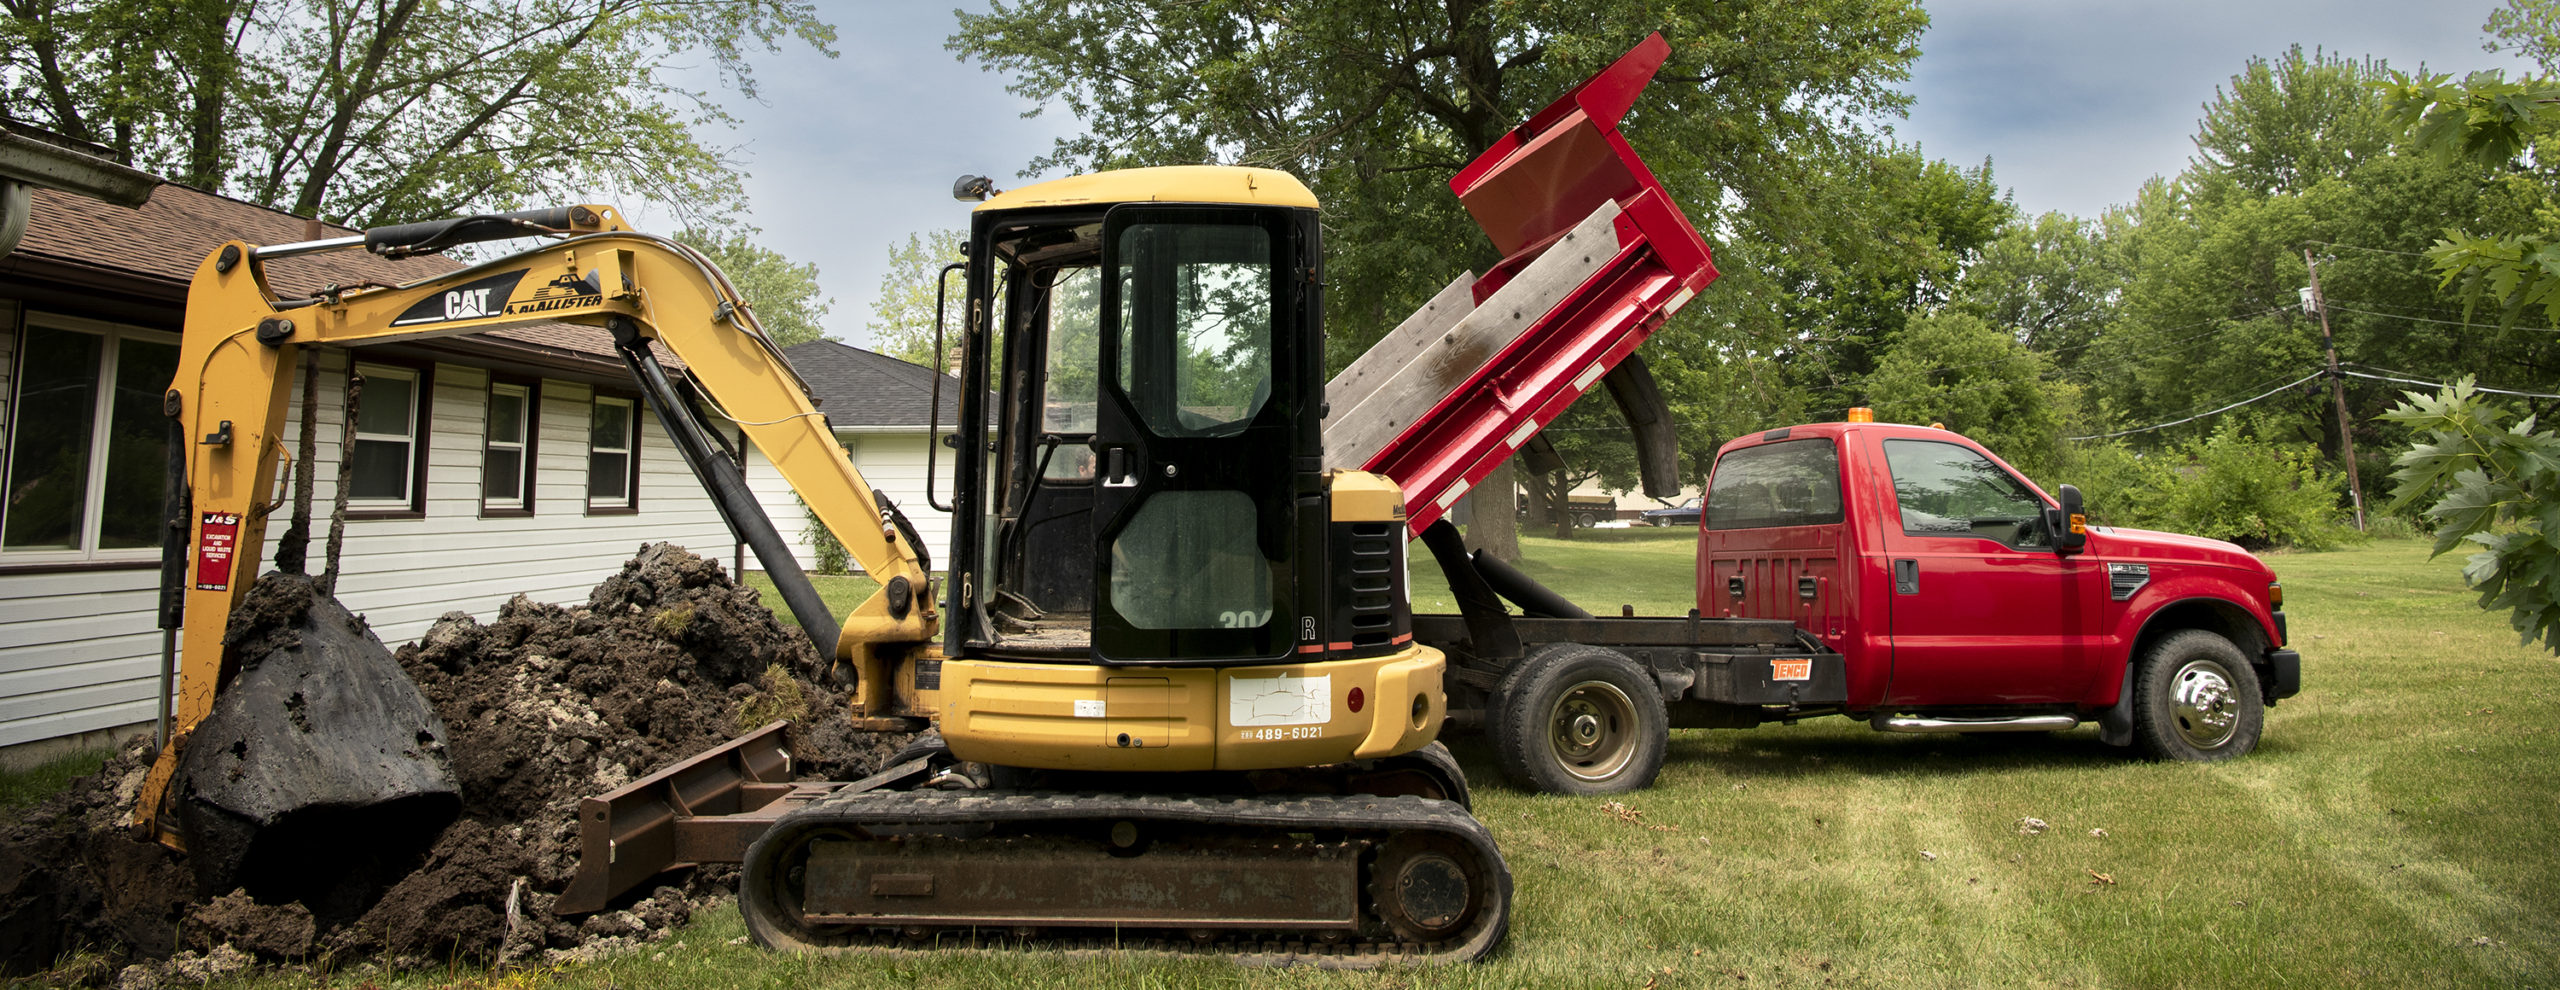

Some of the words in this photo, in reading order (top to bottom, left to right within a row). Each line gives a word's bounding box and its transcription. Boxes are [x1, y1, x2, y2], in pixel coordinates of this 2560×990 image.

[445, 288, 491, 320] CAT
[205, 514, 237, 525] J&S
[1771, 659, 1809, 679] TENCO
[1255, 726, 1322, 740] 489-6021
